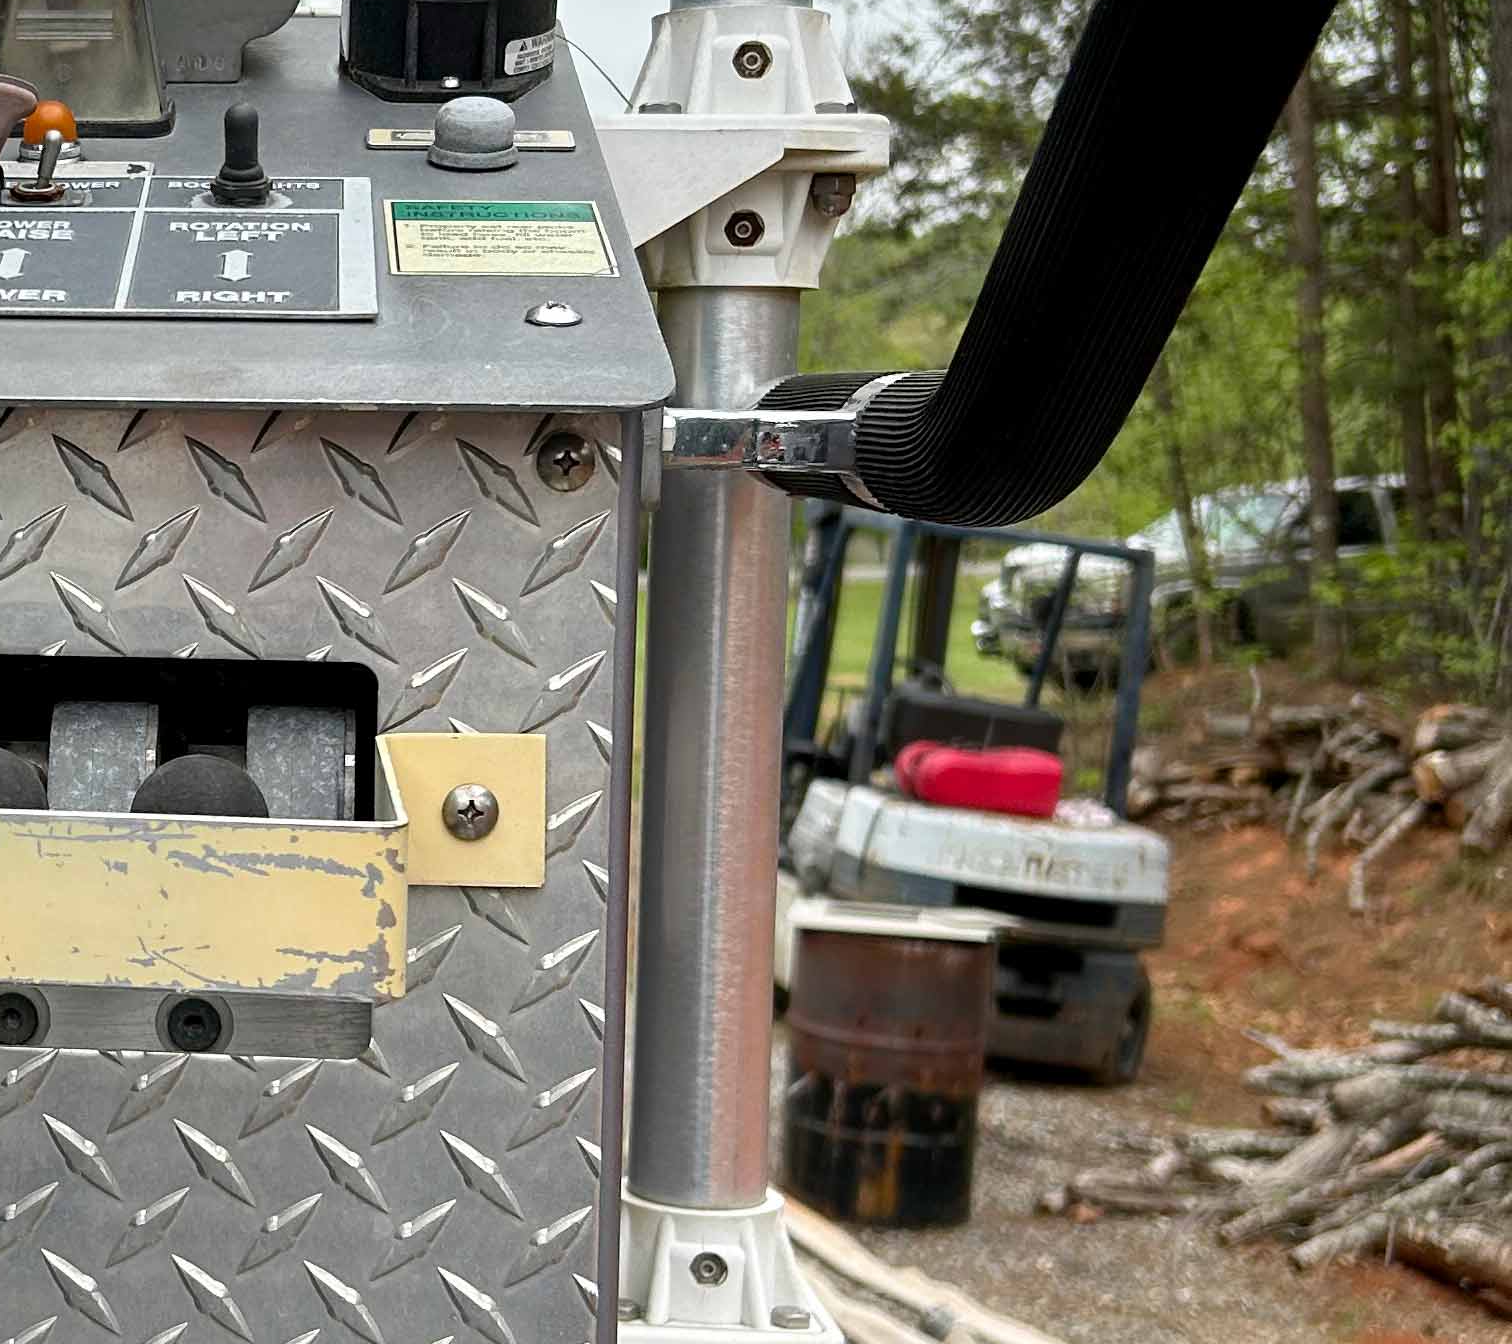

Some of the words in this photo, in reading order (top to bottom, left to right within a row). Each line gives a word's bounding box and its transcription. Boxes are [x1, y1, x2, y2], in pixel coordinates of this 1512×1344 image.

[169, 221, 313, 233] ROTATION
[195, 231, 284, 243] LEFT
[175, 290, 292, 305] RIGHT
